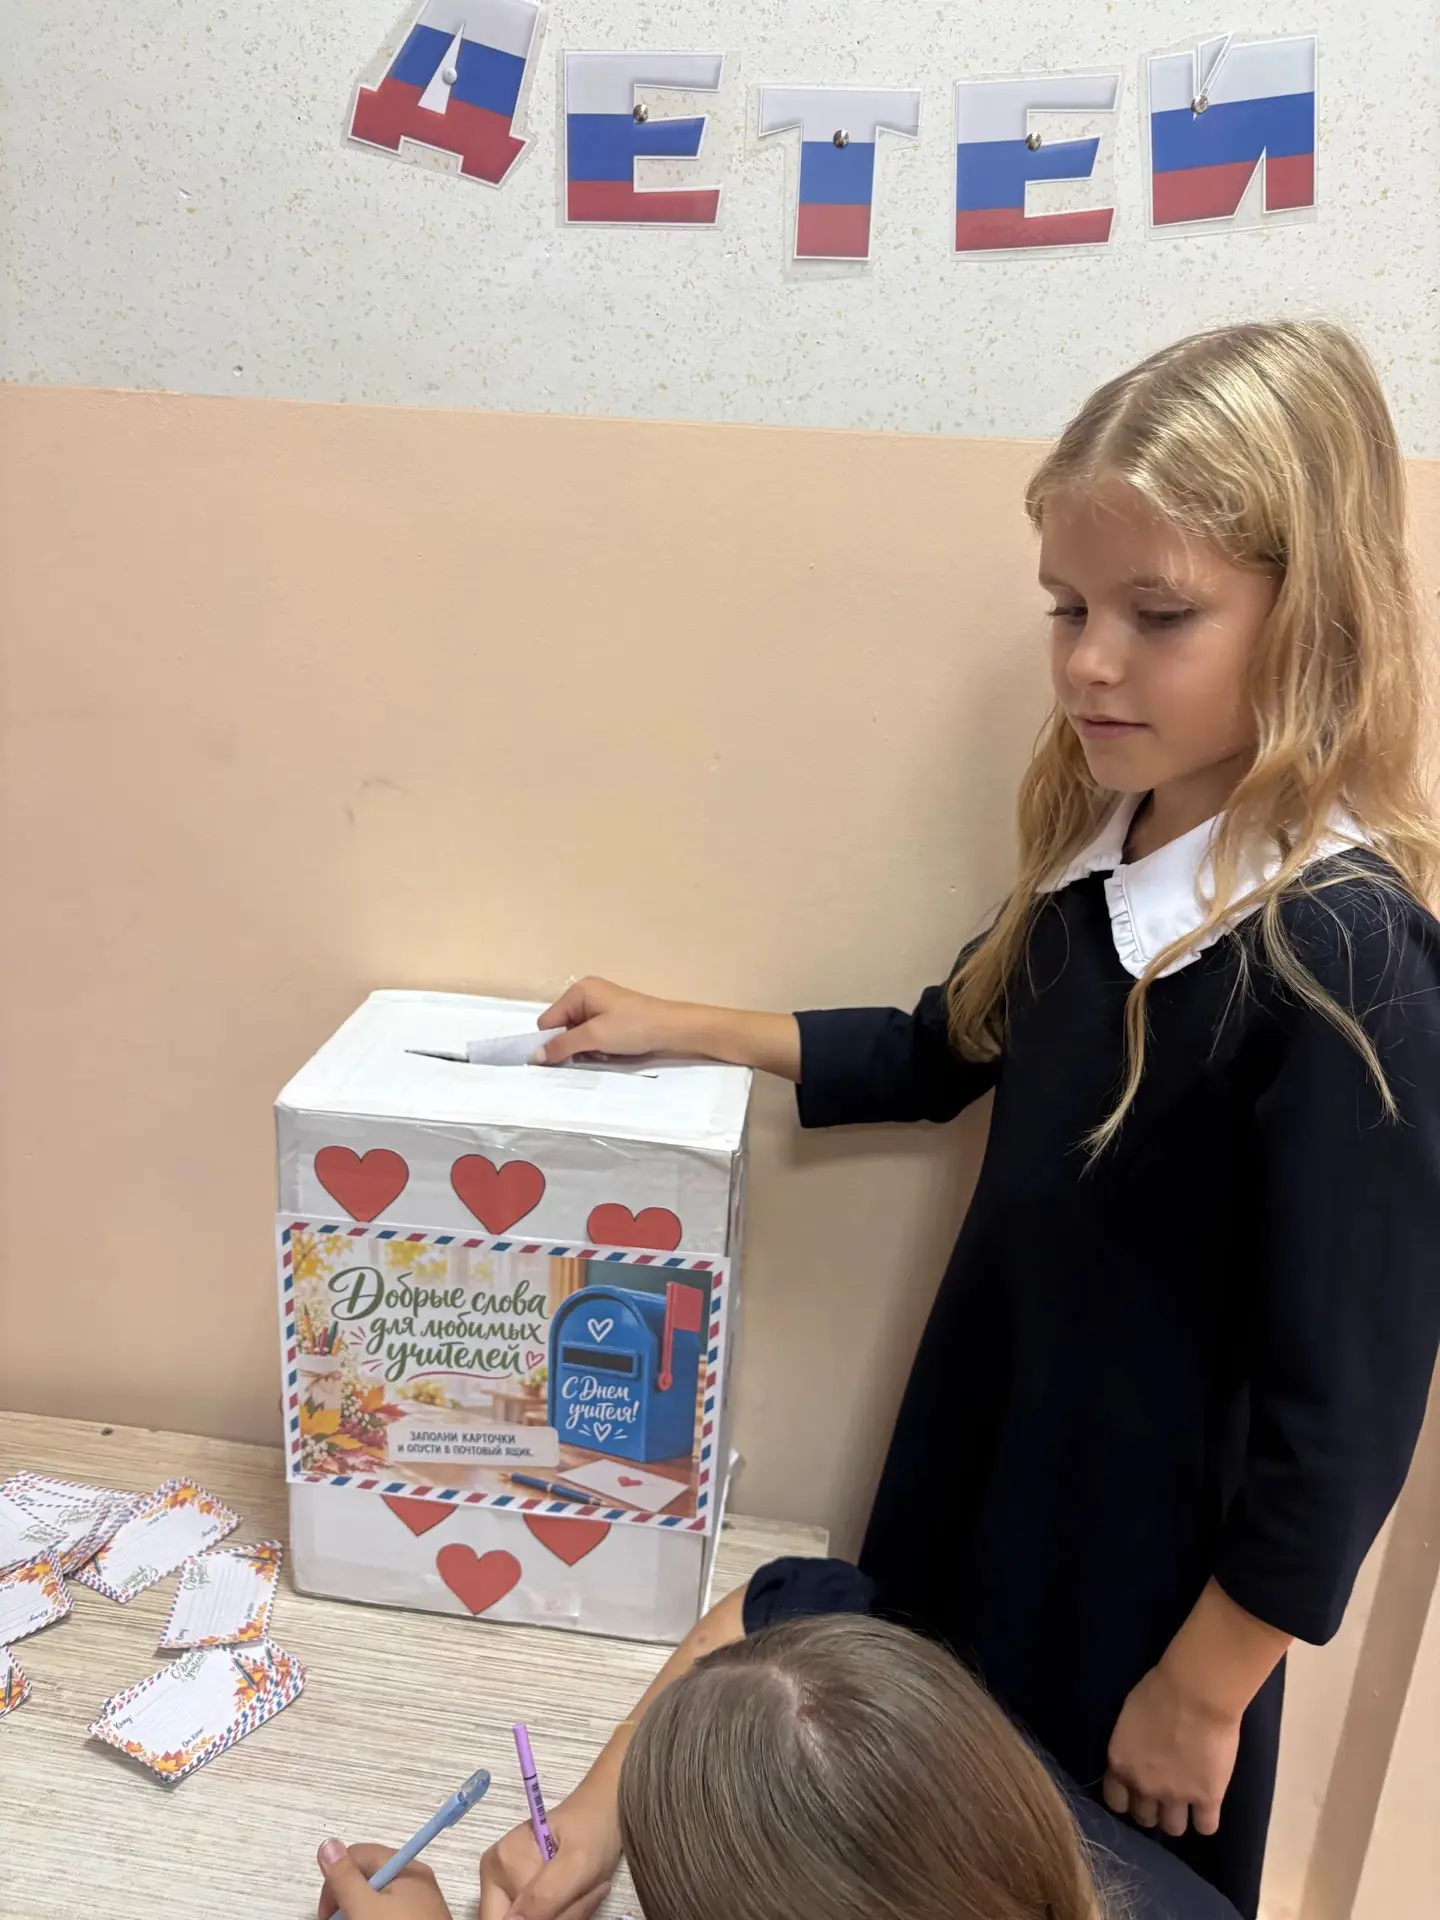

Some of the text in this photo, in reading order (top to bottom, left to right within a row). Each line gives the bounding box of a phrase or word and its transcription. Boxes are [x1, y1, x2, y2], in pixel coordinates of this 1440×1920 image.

[327, 1266, 549, 1321] Добрые слова
[365, 1310, 546, 1355] для любимых
[384, 1341, 526, 1382] учителей
[561, 1375, 632, 1402] С Днем
[565, 1400, 640, 1430] учителя!
[397, 1443, 534, 1458] И ОПУСТИ В ПОЧТОВЫЙ ЯЩИК.
[409, 1430, 517, 1445] ЗАПОЛНИ КАРТОЧКИ
